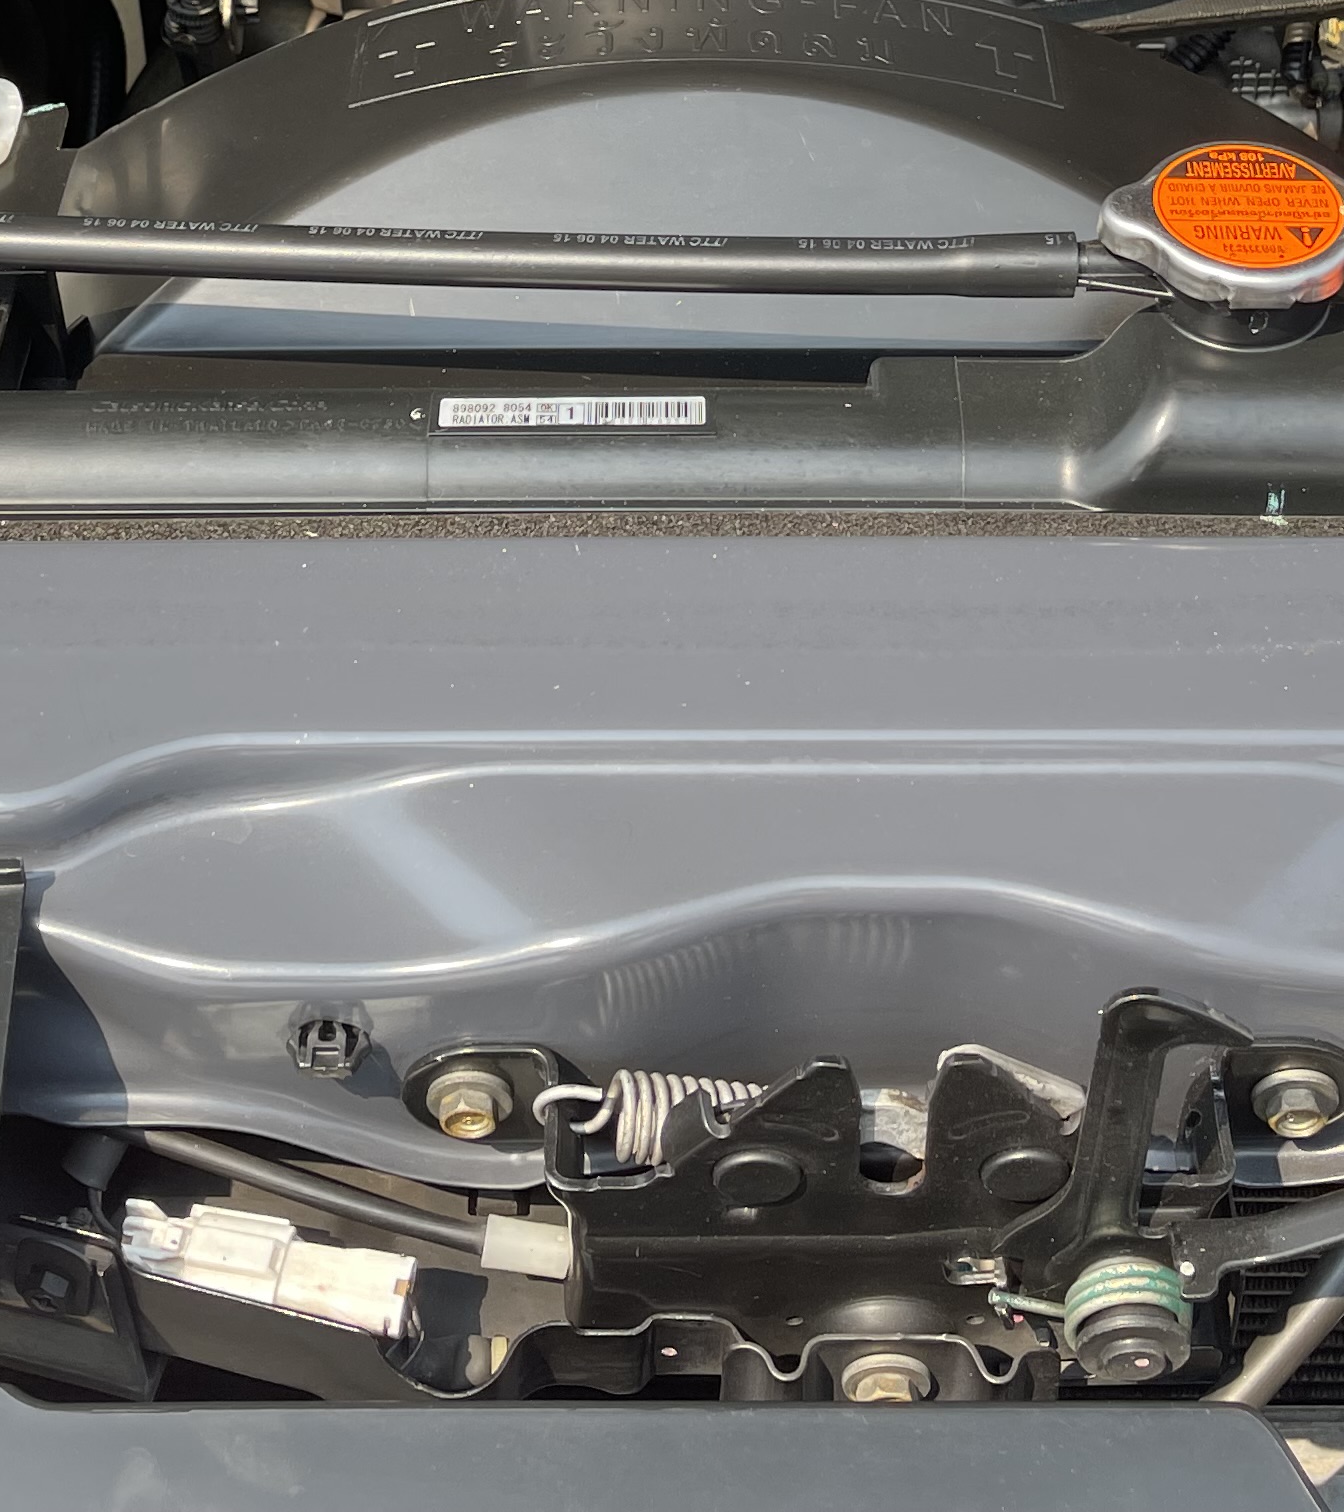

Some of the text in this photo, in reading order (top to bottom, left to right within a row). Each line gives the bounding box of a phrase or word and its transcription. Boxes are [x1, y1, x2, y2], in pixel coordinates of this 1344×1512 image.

[1185, 161, 1296, 180] AVERTISSEMENT
[1219, 183, 1259, 193] OUVRIR
[1261, 183, 1305, 194] JAMAIS
[1308, 184, 1326, 194] NE
[1200, 196, 1240, 206] WHEN
[1246, 197, 1280, 207] OPEN
[1287, 198, 1329, 208] NEVER
[106, 218, 126, 228] 06
[131, 219, 149, 228] 04
[153, 220, 216, 231] WATER
[357, 227, 375, 236] 04
[379, 228, 441, 239] WATER
[1193, 225, 1282, 240] WARNING
[601, 235, 619, 245] 04
[624, 235, 684, 246] WATER
[798, 239, 814, 250] 15
[847, 239, 865, 249] 04
[870, 238, 934, 249] WATER
[452, 403, 496, 413] 898092
[503, 403, 531, 412] 8054
[567, 406, 574, 420] 1
